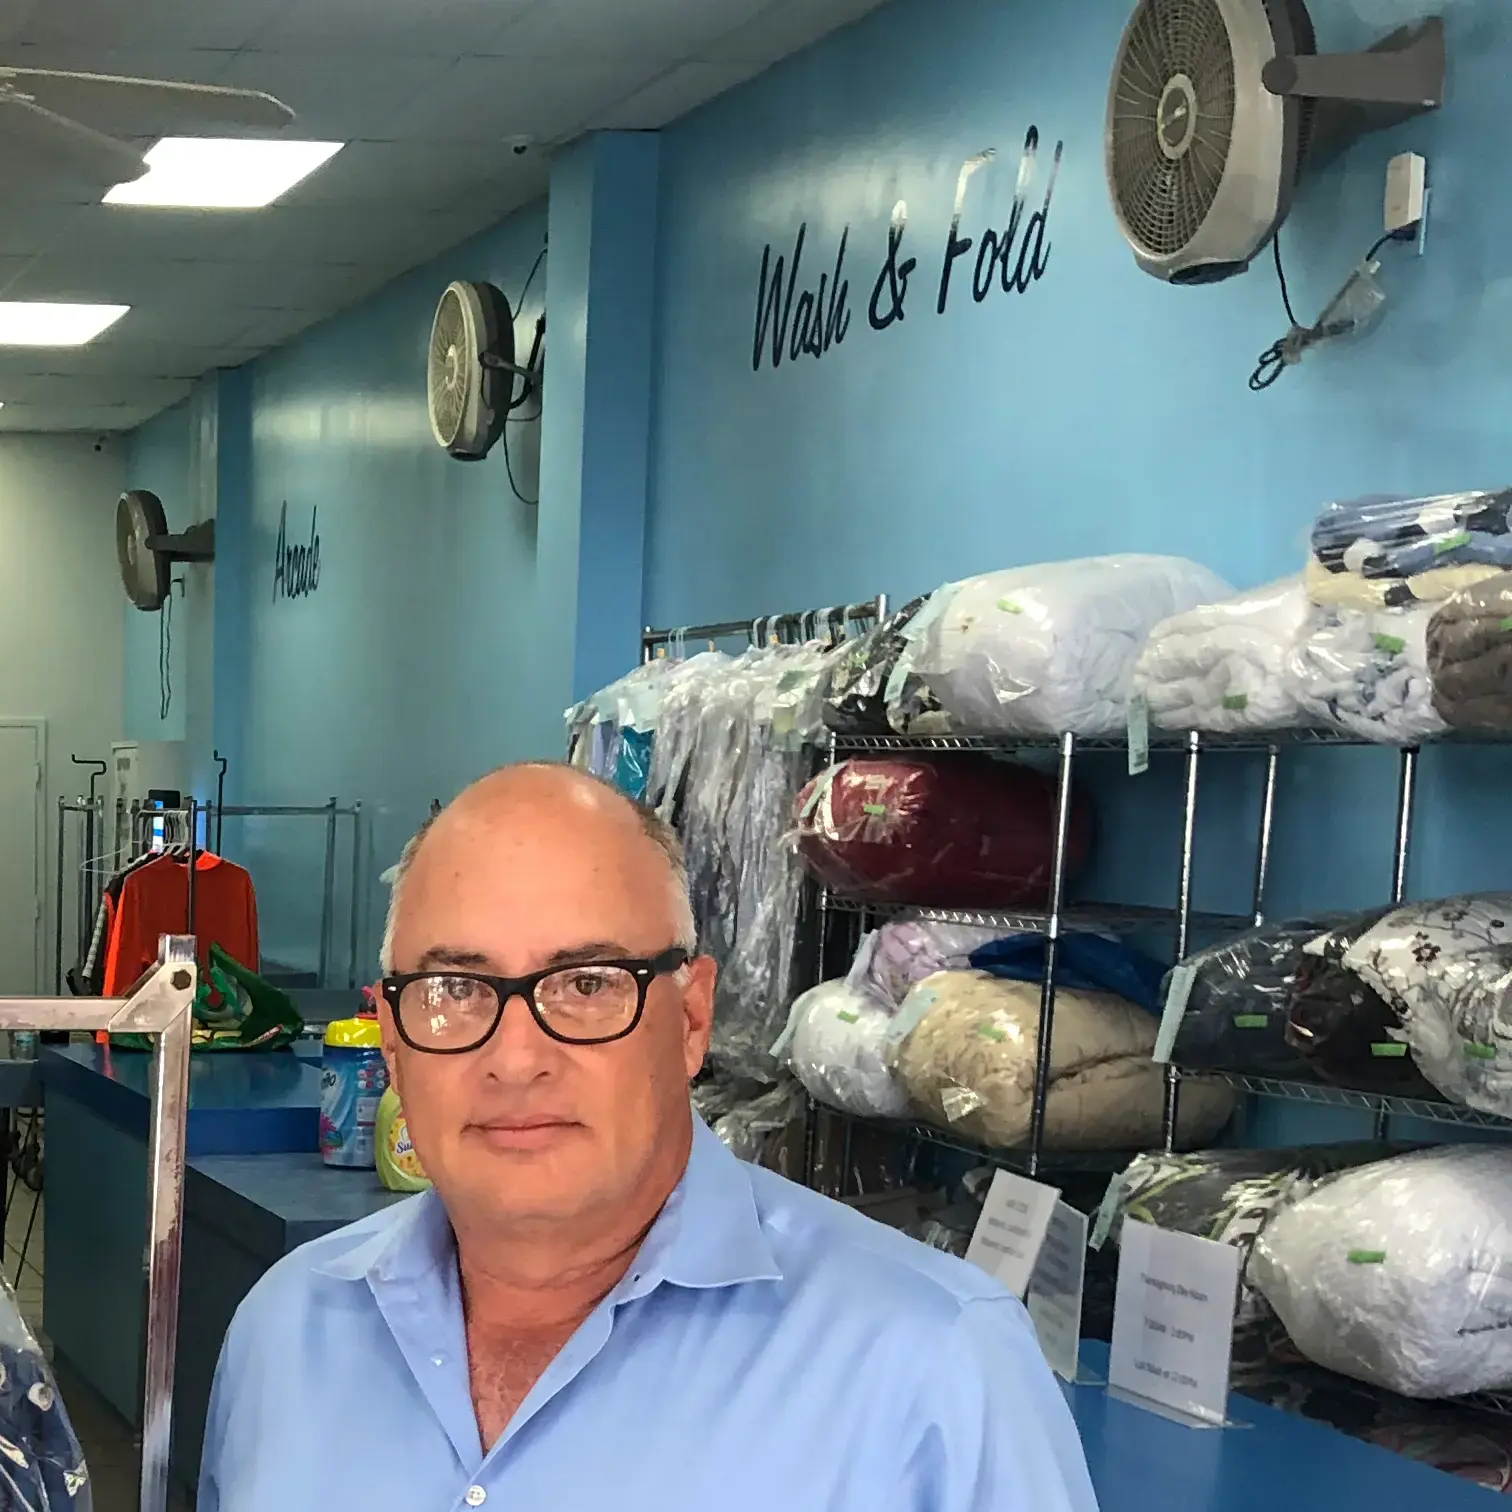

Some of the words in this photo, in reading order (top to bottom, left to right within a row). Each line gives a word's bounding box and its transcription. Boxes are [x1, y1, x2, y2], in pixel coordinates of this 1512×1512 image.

[752, 222, 851, 372] Wash
[868, 200, 917, 330] &
[937, 125, 1064, 314] Fold
